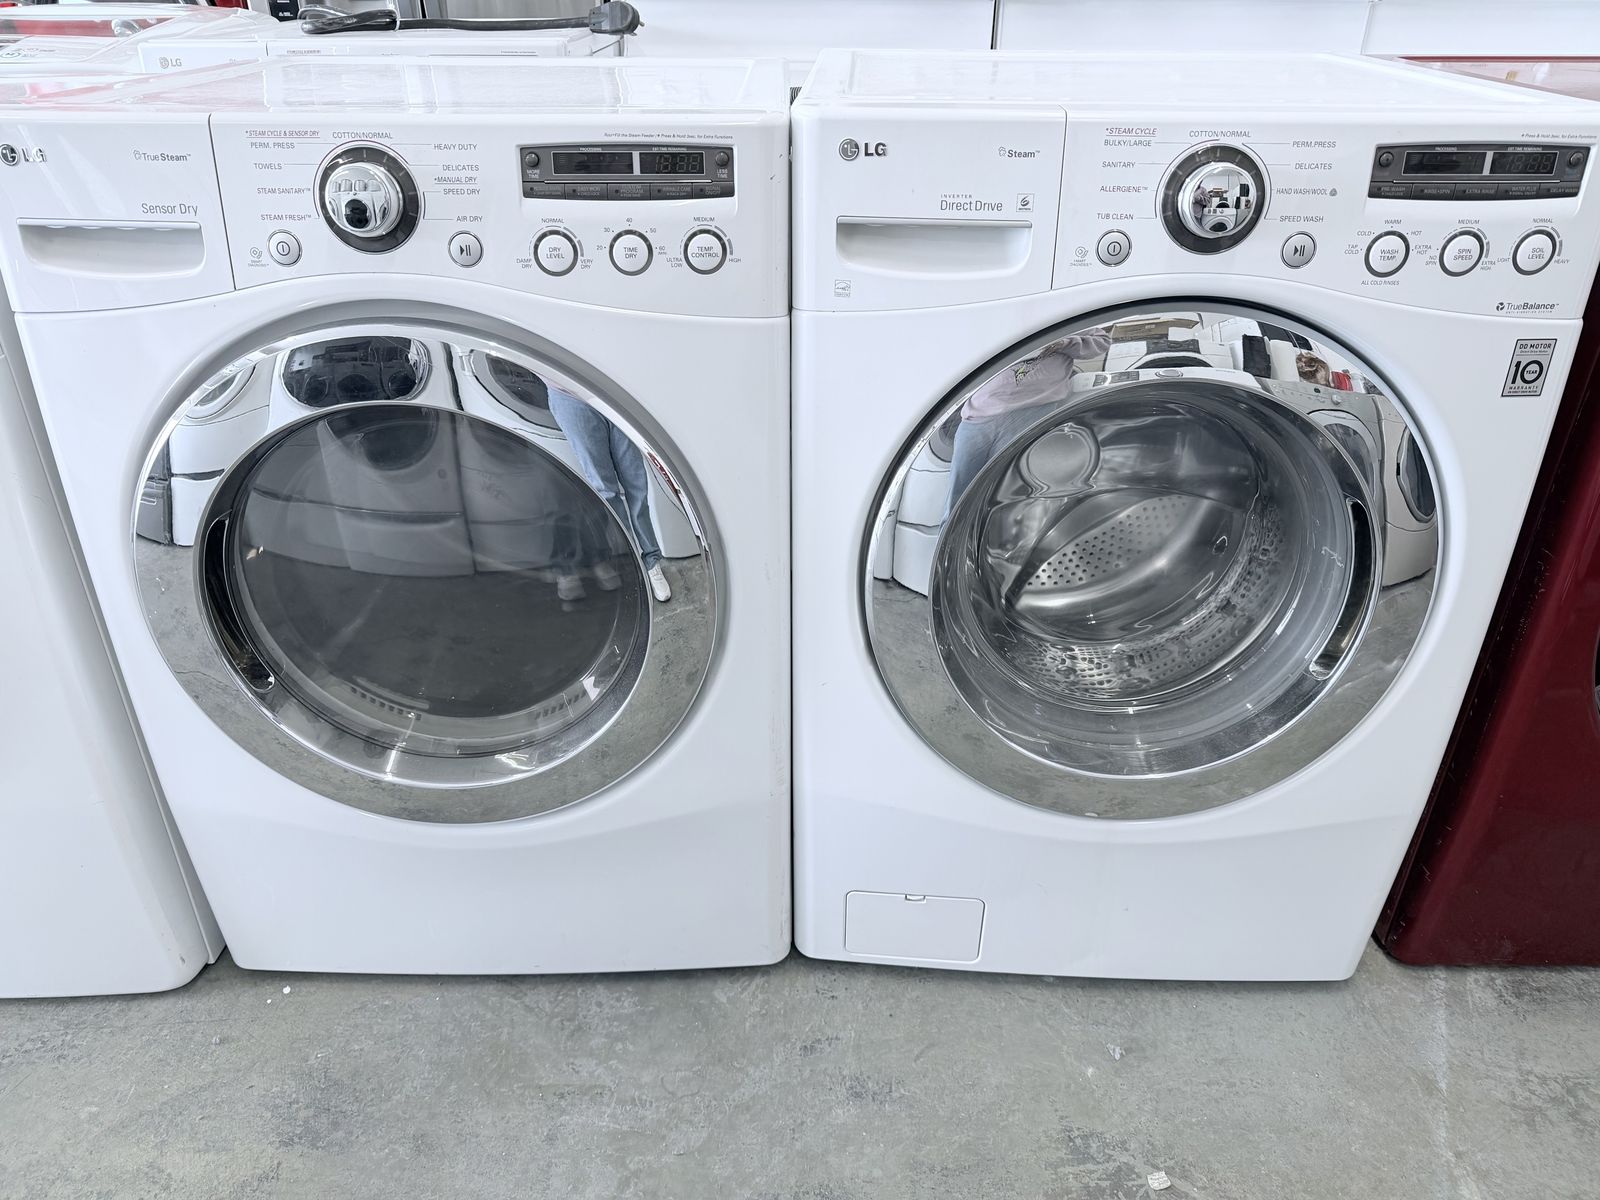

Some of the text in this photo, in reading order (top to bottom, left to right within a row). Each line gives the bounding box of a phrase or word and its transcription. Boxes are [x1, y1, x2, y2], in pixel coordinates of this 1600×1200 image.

[170, 59, 182, 67] LG
[332, 131, 392, 139] COTTON/NORMAL
[1189, 130, 1252, 138] COTTON/NORMAL
[1104, 139, 1152, 147] BULKY/LARGE
[21, 148, 47, 162] LG
[864, 142, 888, 157] LG
[141, 203, 198, 216] Sensor Dry
[940, 199, 1003, 211] Direct Drive
[1511, 360, 1544, 384] 10
